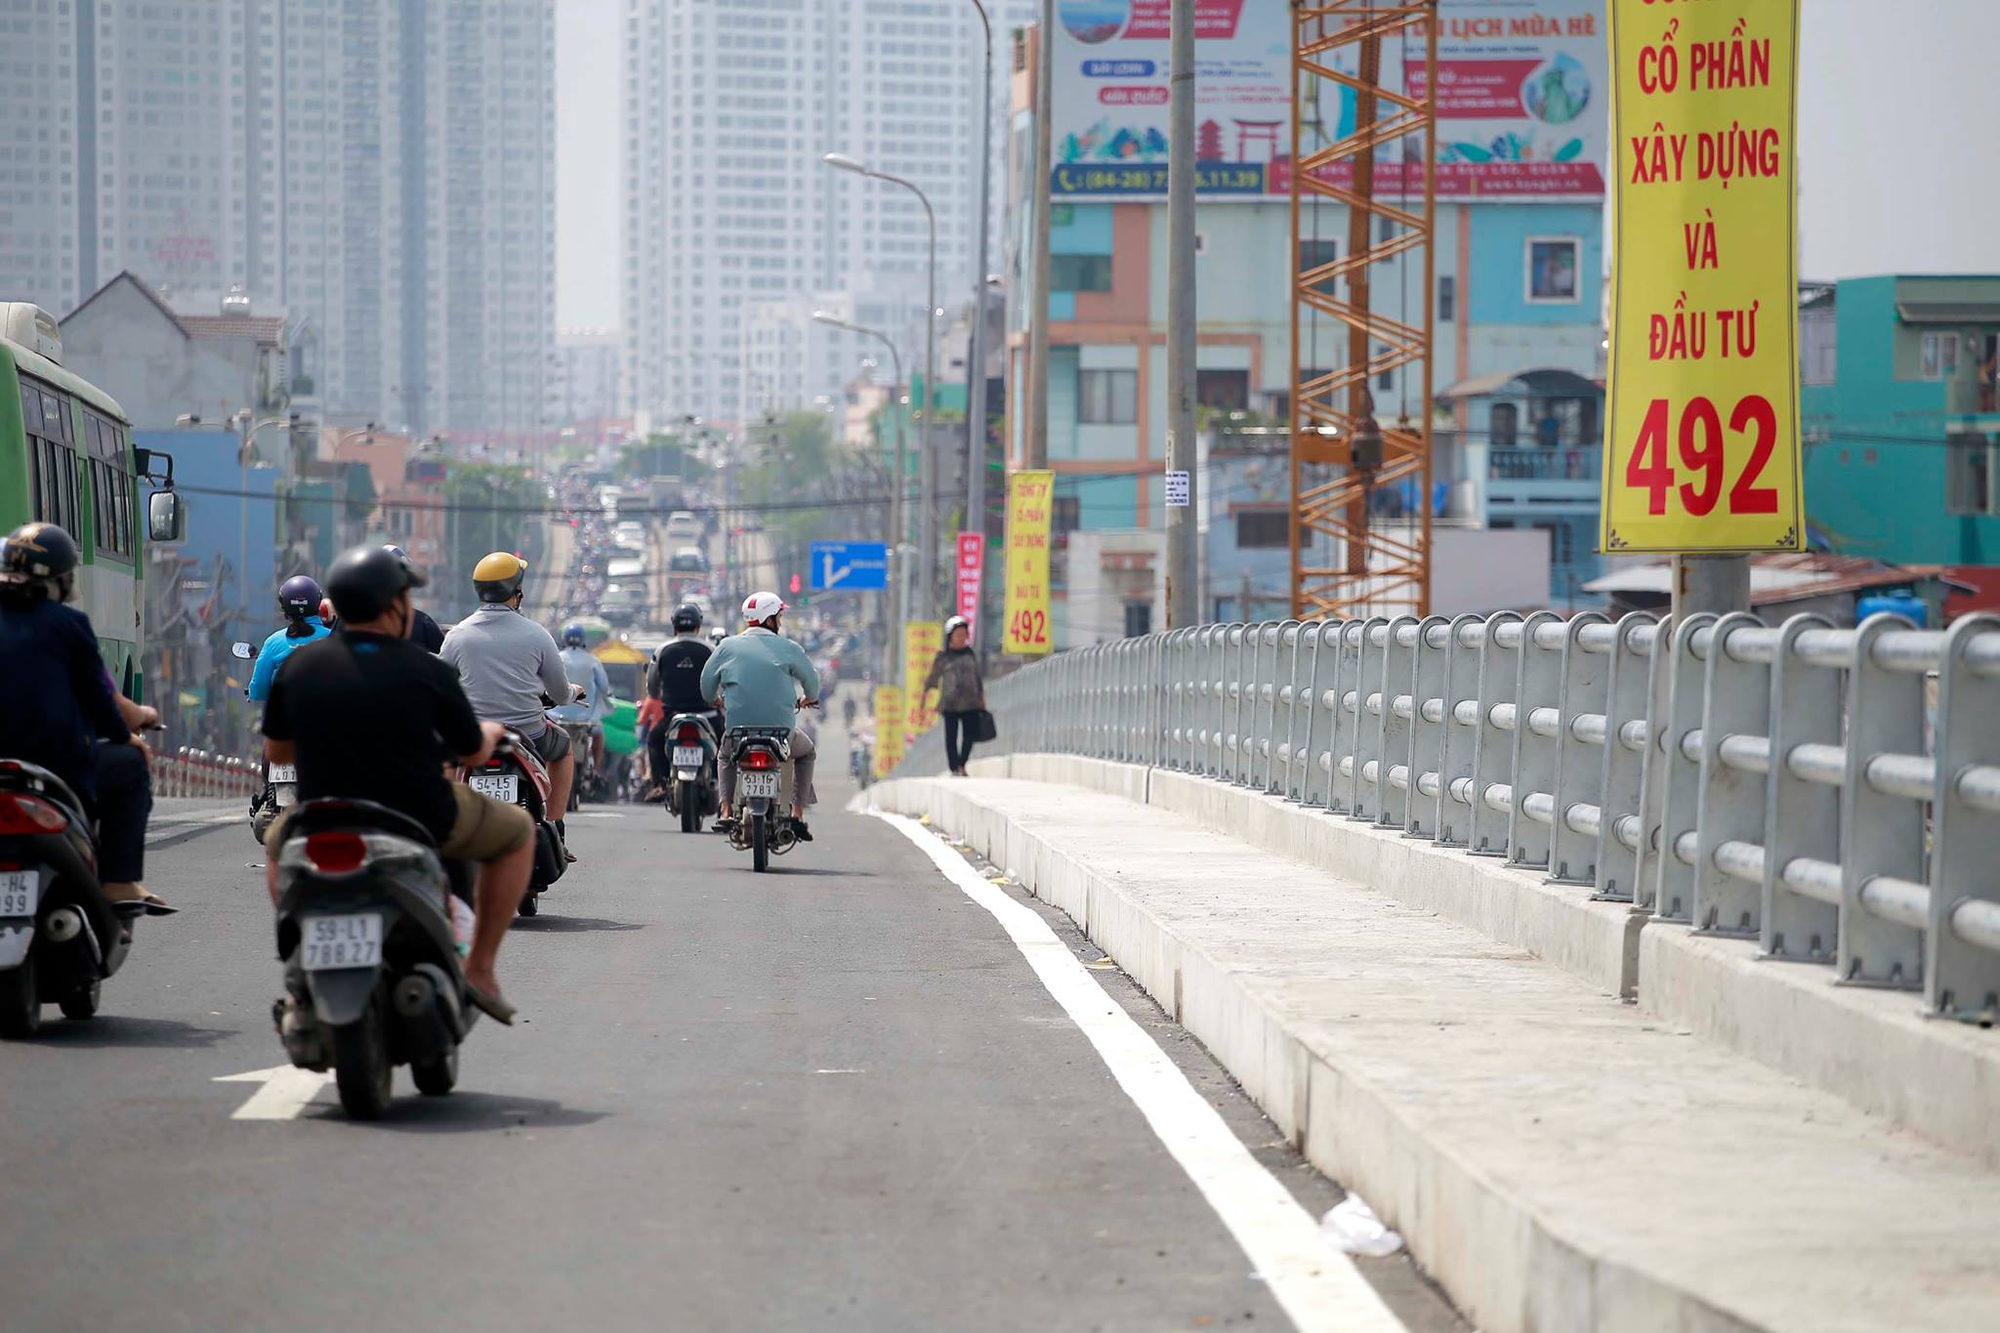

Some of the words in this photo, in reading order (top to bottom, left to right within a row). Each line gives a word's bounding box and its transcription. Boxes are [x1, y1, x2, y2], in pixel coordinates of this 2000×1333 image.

[1638, 18, 1679, 95] CỔ
[1690, 17, 1770, 91] PHẦN
[1631, 122, 1687, 184] XÂY
[1697, 121, 1780, 189] DỰNG
[1684, 208, 1718, 270] VÀ
[1649, 290, 1706, 360] ĐẦU
[1716, 299, 1760, 358] TƯ
[1626, 395, 1778, 516] 492
[1010, 610, 1046, 643] 492
[477, 777, 509, 790] 54-L5
[0, 895, 26, 913] 99
[316, 919, 367, 941] 59-L1
